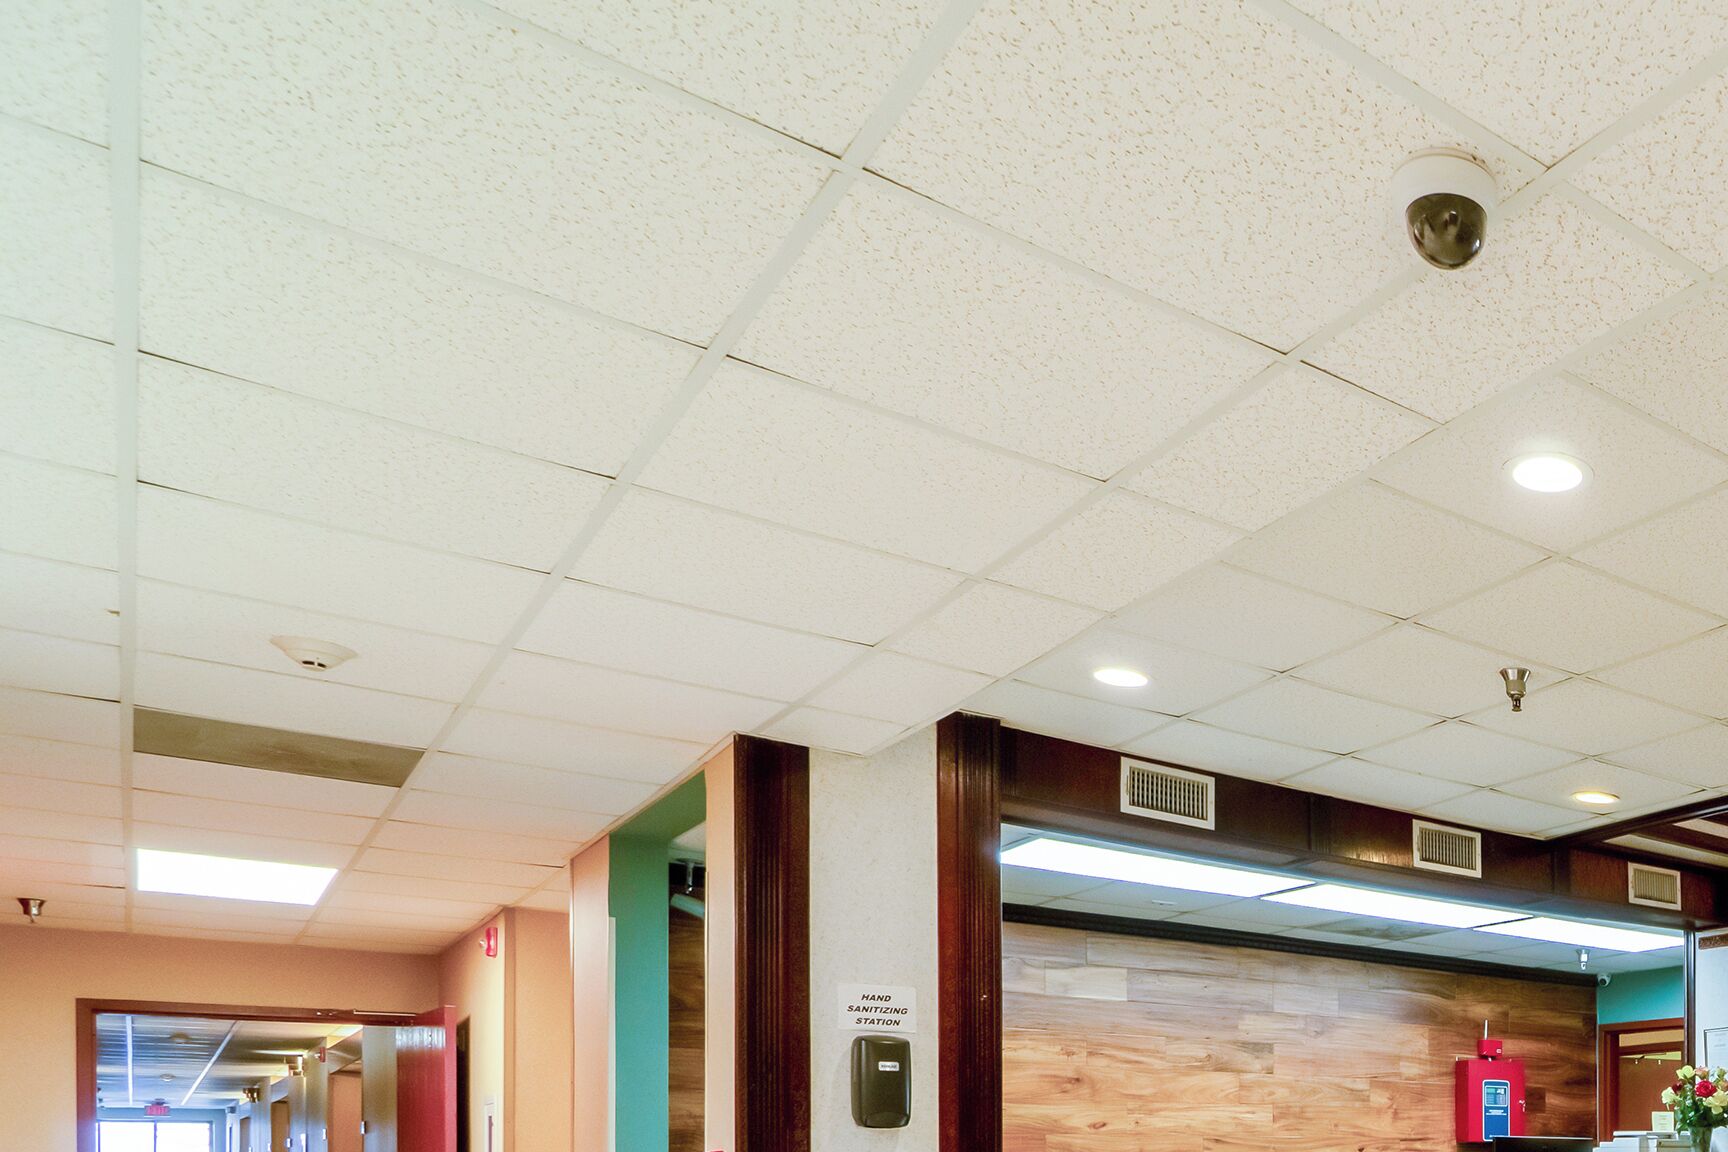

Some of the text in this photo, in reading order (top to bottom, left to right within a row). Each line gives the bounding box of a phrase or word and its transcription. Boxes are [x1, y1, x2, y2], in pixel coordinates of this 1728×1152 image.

[861, 994, 892, 1002] HAND
[847, 1005, 909, 1015] SANITIZING
[855, 1017, 901, 1026] STATION
